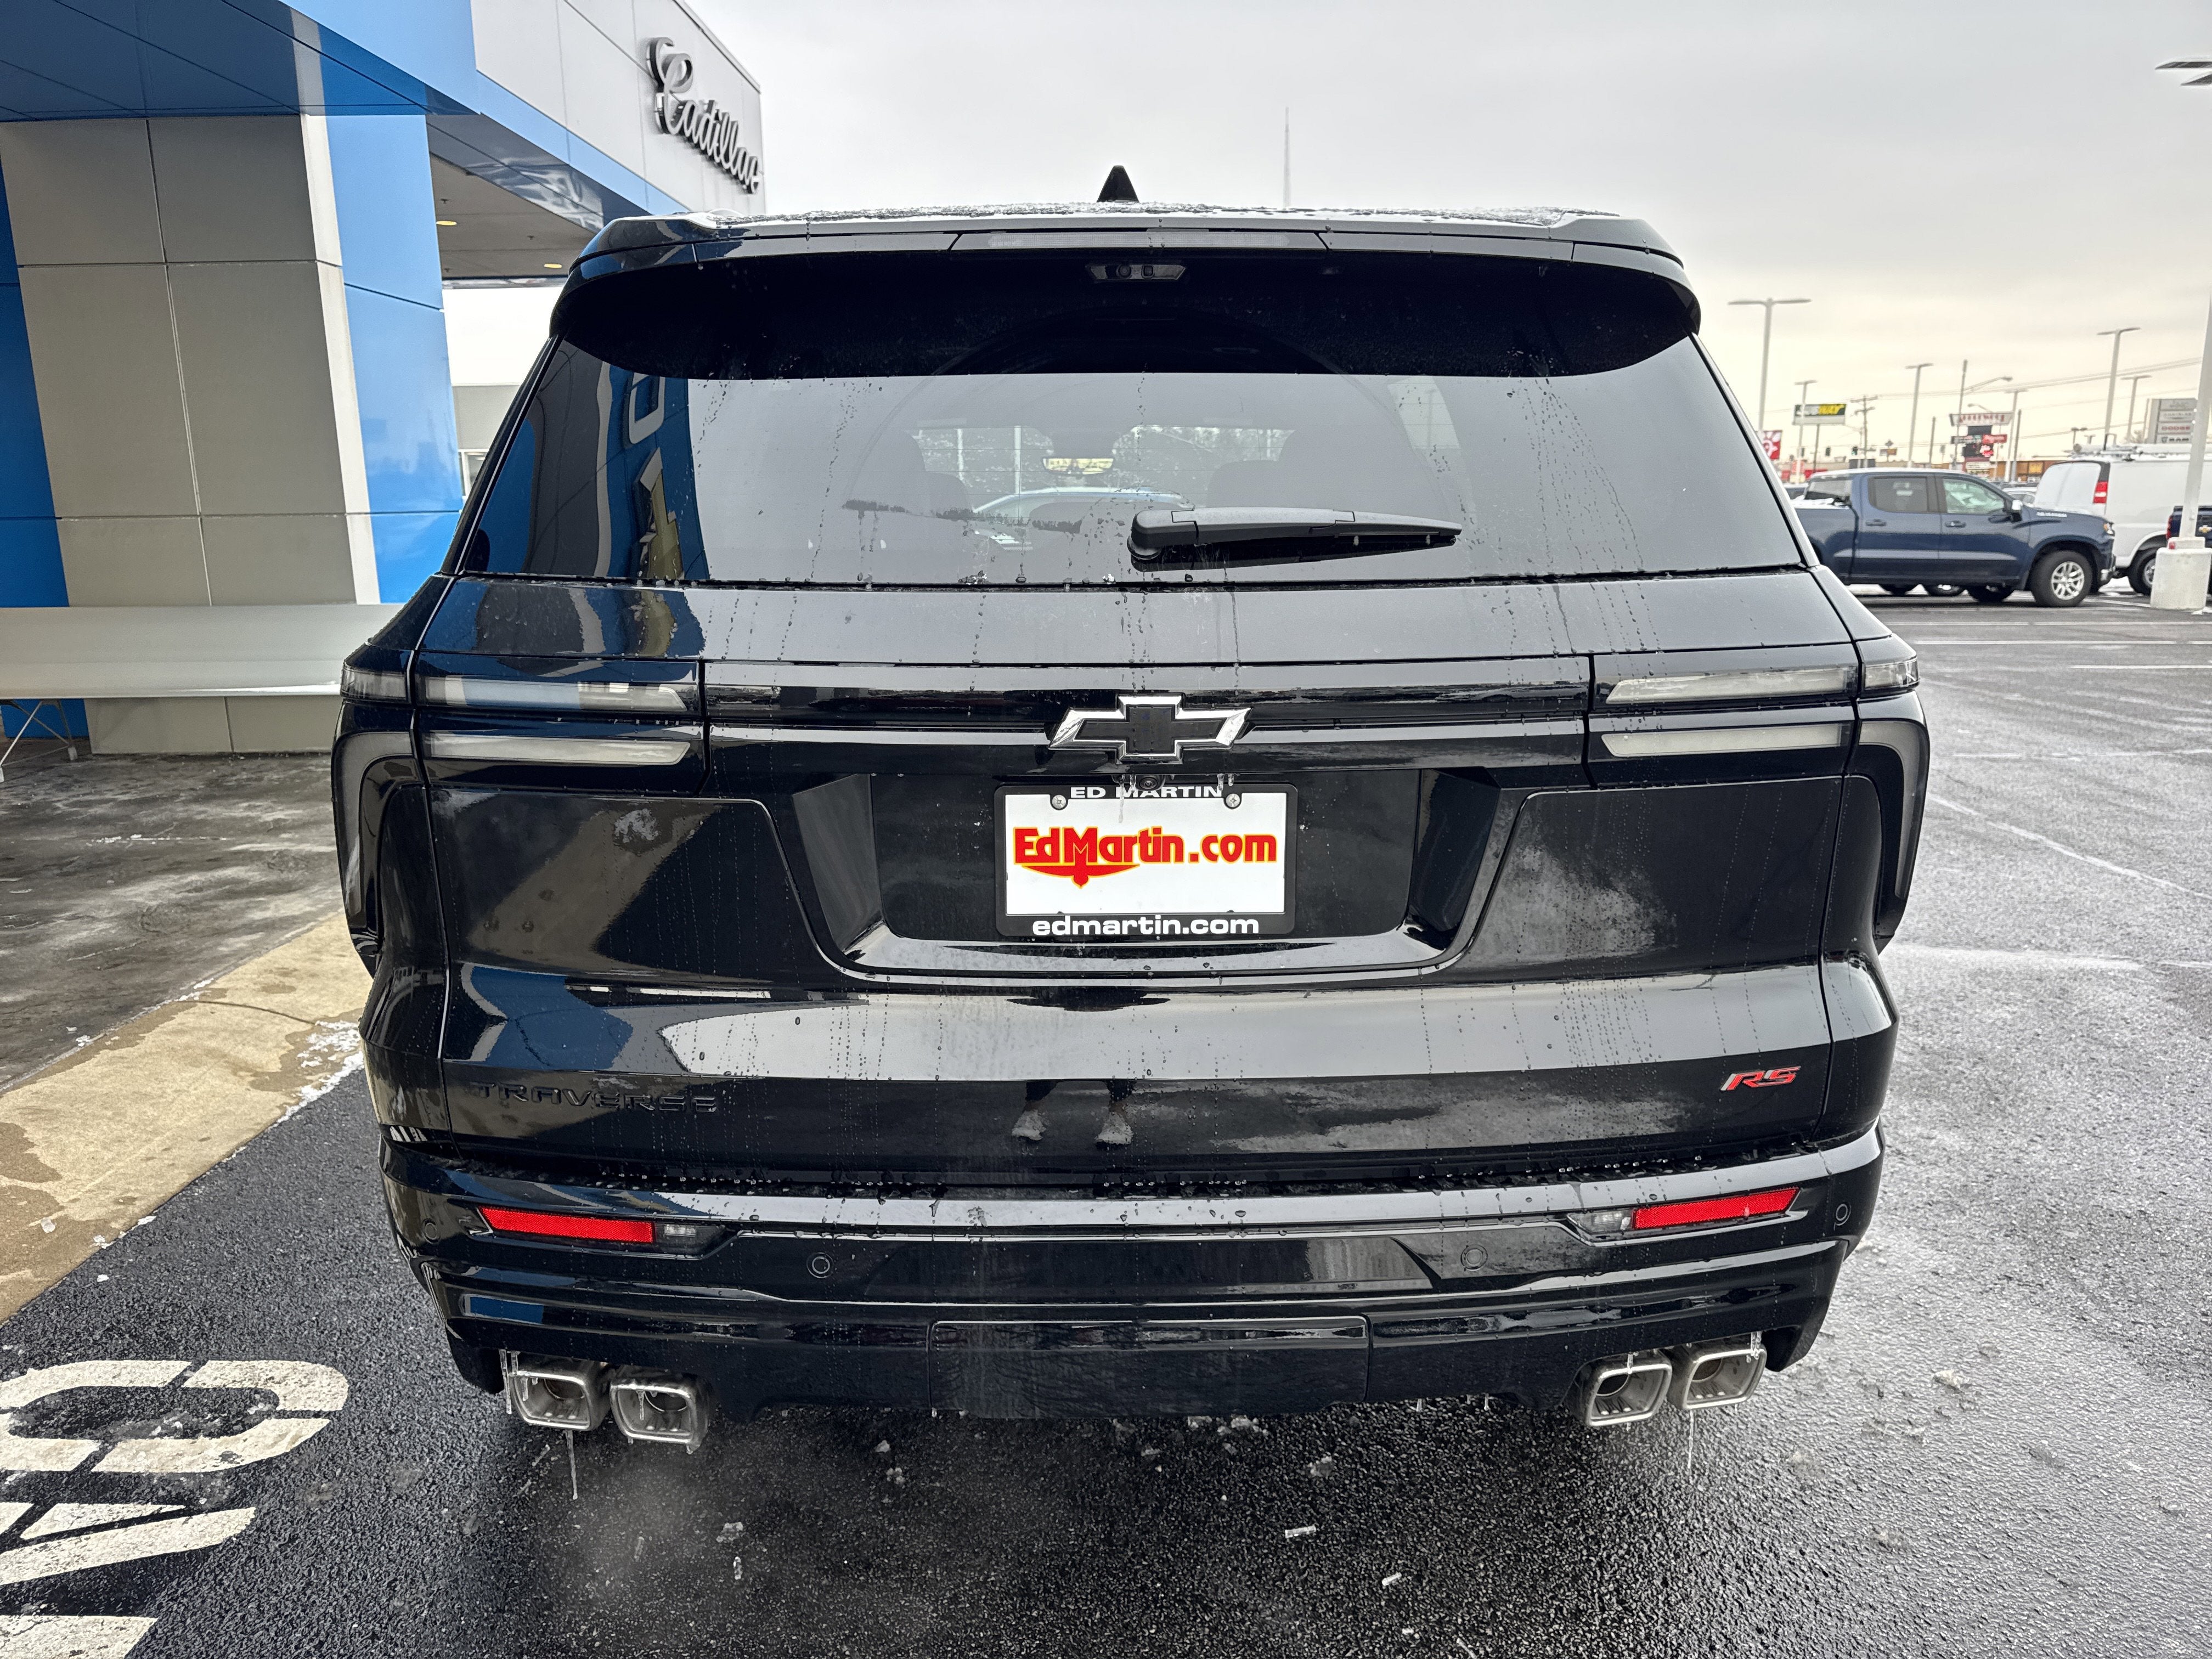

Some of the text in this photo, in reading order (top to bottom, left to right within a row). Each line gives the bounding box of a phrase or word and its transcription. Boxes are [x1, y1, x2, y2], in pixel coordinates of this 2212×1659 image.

[646, 37, 759, 194] Cadillac
[1070, 785, 1222, 799] ED MARTIN
[1013, 826, 1278, 867] EdMartin.com
[1032, 915, 1259, 935] edmartin.com
[1719, 1065, 1801, 1091] RS
[469, 1082, 718, 1113] TRAVERSE
